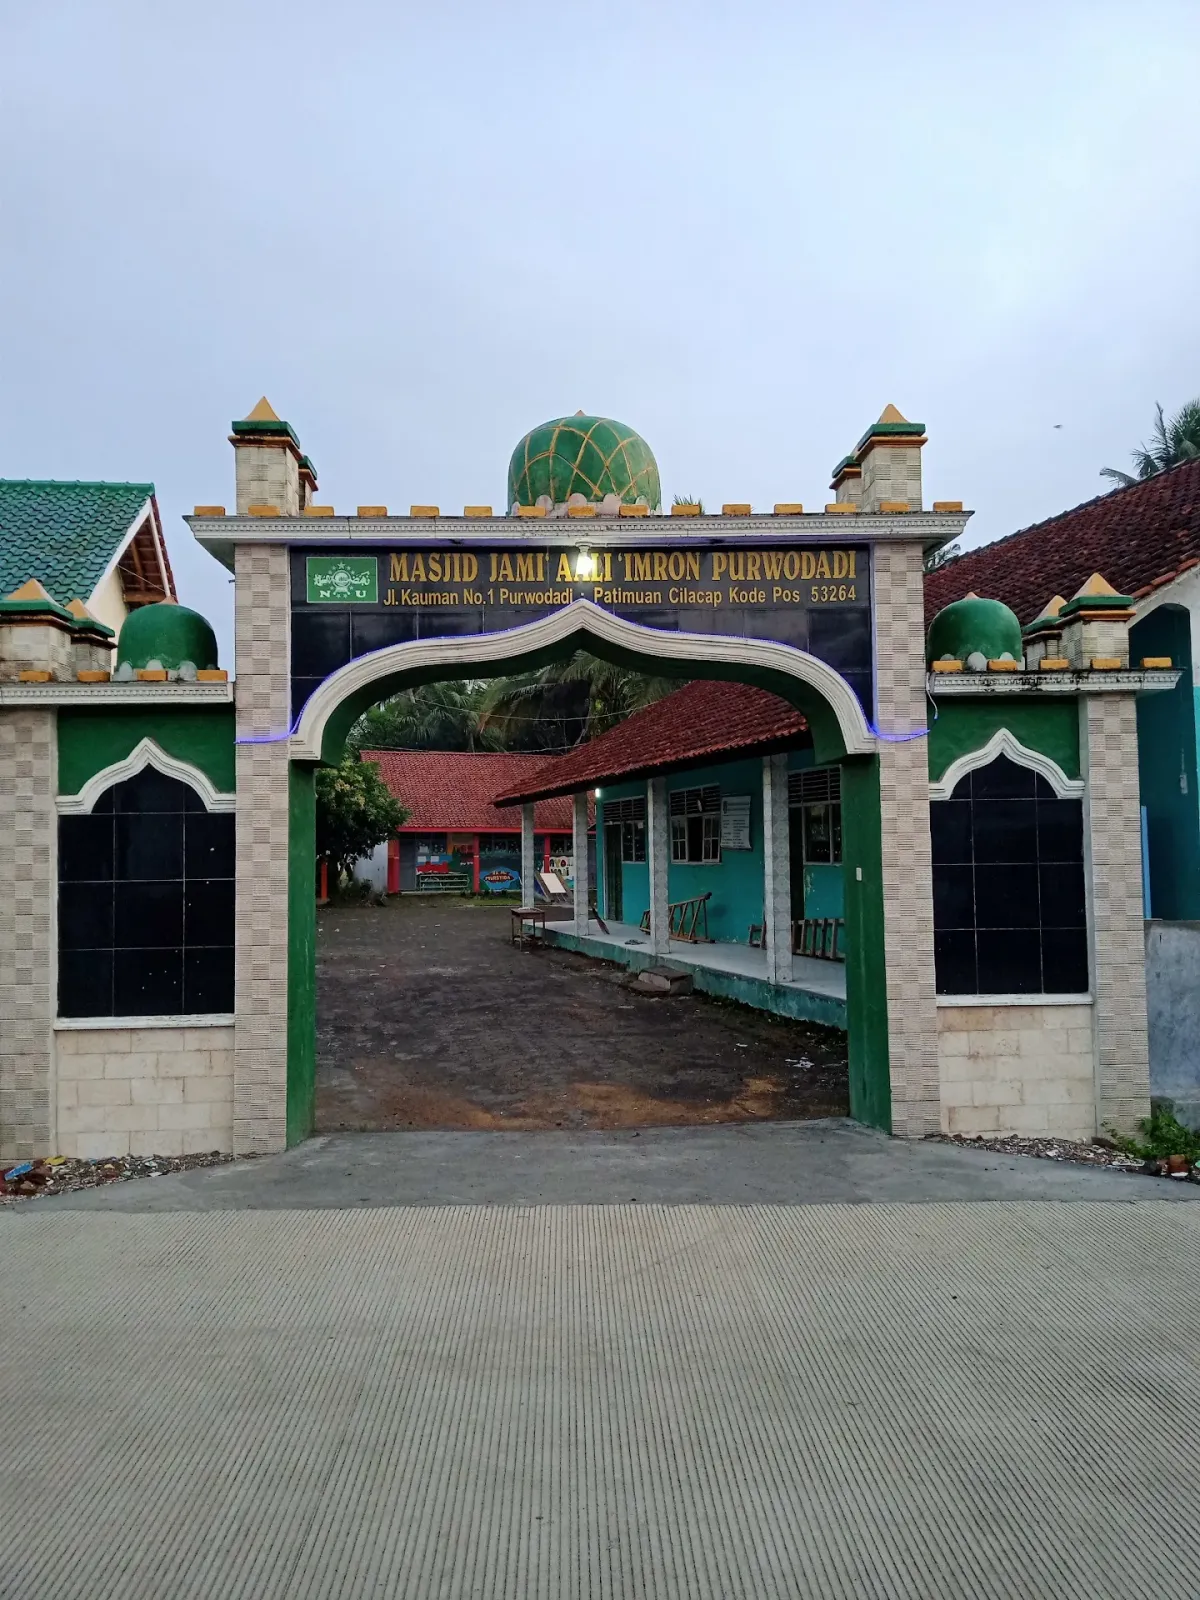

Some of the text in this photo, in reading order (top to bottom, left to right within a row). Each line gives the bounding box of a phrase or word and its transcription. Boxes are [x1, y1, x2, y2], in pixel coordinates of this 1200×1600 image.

[389, 552, 478, 582] MASJID
[711, 551, 857, 580] PURWODADI
[319, 590, 367, 598] N U
[401, 588, 459, 605] Kauman
[463, 588, 494, 604] No.1
[500, 587, 574, 605] Purwodadi
[593, 586, 662, 604] Patimuan
[668, 587, 722, 606] Cilacap
[729, 586, 766, 603] Kode
[773, 586, 800, 602] Pos
[810, 585, 857, 602] 53264
